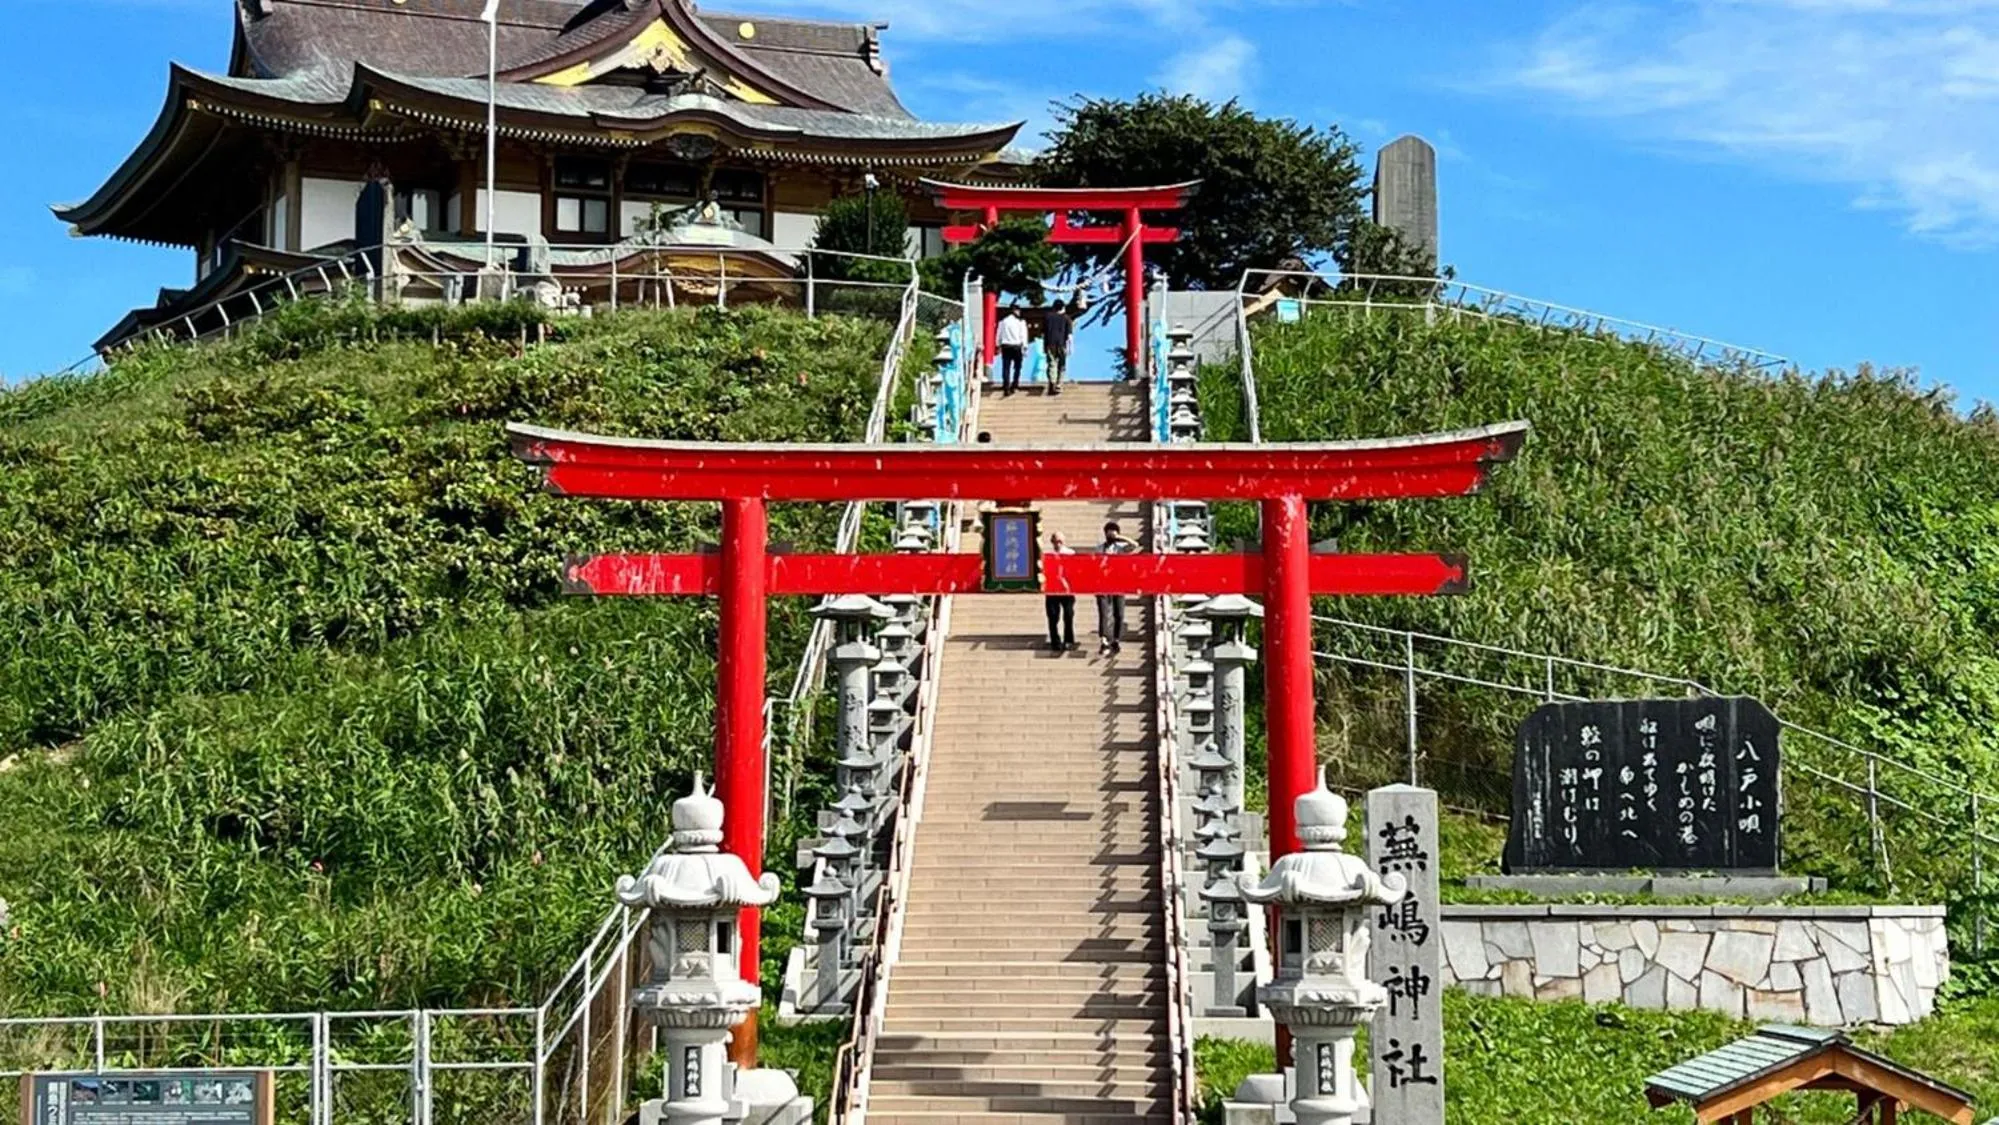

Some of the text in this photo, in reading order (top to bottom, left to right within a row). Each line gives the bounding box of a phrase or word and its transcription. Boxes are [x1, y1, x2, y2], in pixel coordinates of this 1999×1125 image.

[1618, 765, 1639, 838] 南へ北へ
[1736, 740, 1763, 835] 八戸小唄
